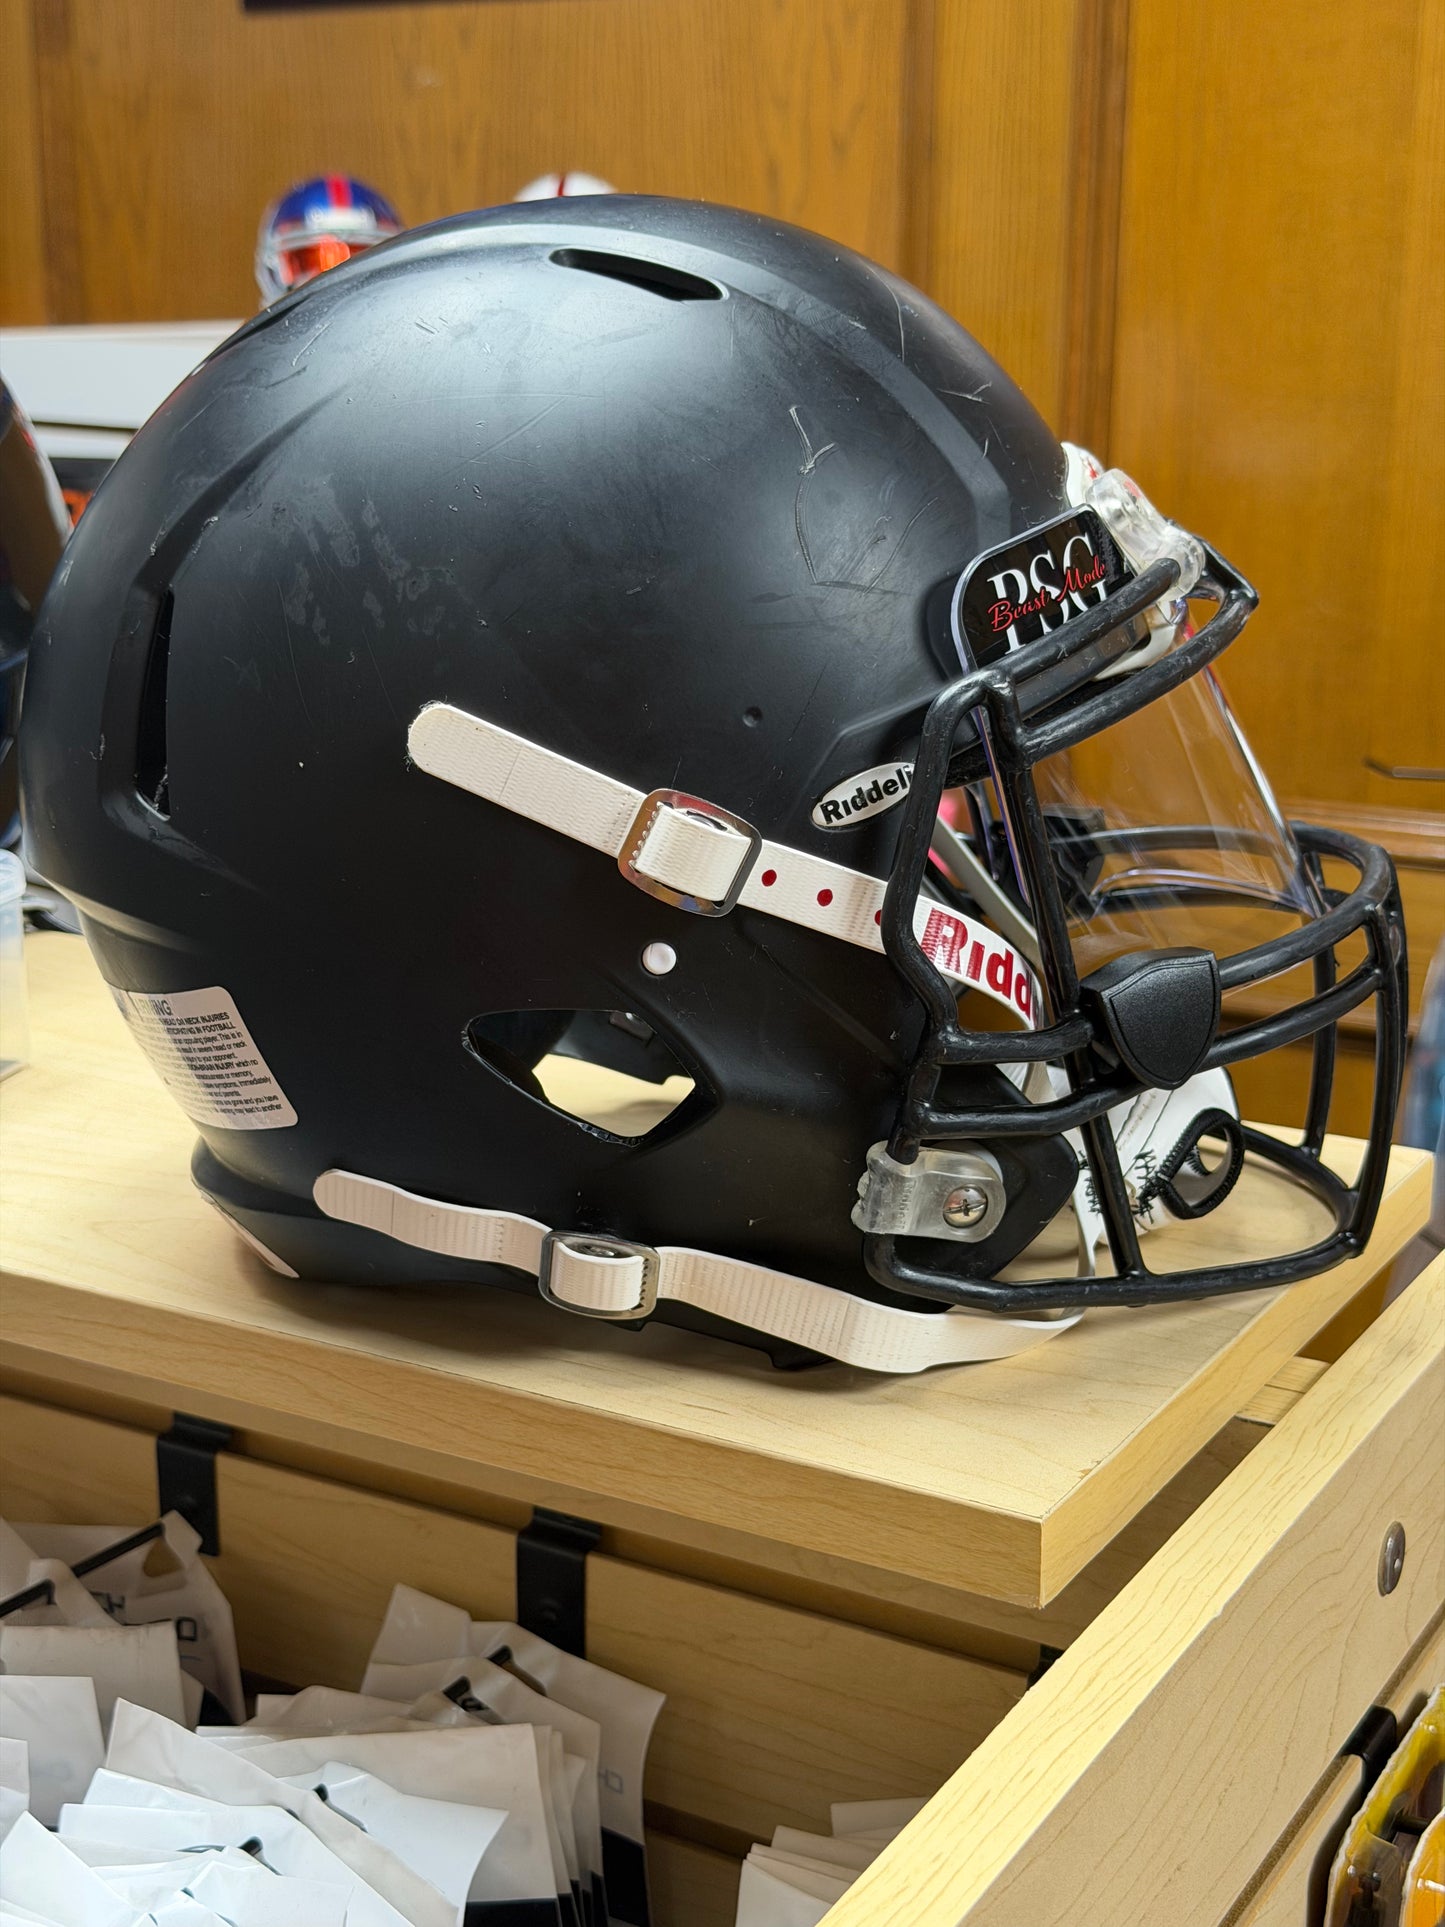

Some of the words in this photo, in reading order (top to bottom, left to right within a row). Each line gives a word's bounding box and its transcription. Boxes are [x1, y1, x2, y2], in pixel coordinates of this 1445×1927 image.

[987, 586, 1050, 632] Beast
[1057, 555, 1106, 602] Mode
[201, 1012, 229, 1023] INJURIES
[203, 1022, 236, 1033] FOOTBALL
[218, 1033, 229, 1041] This
